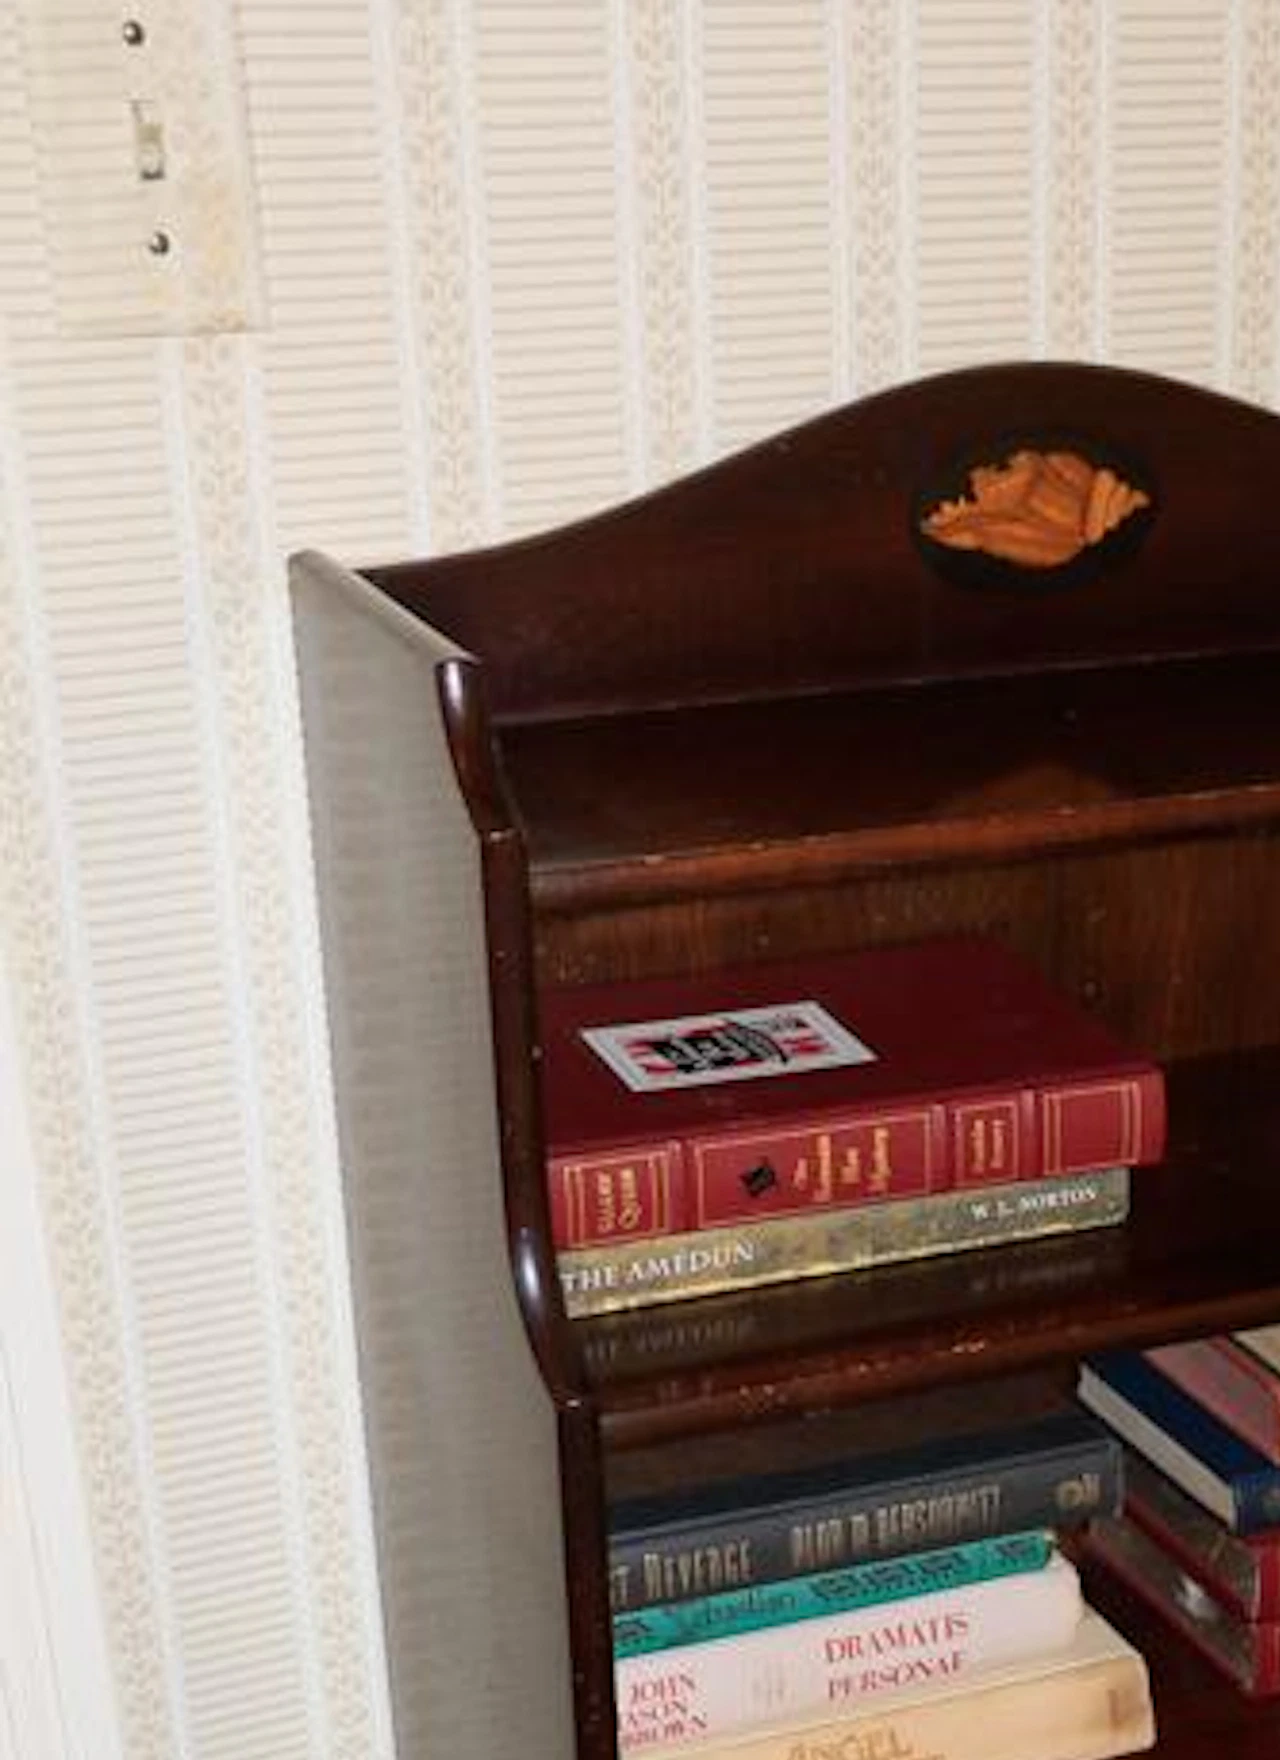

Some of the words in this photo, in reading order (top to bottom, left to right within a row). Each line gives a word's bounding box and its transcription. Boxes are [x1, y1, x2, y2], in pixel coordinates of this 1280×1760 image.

[1018, 1186, 1098, 1213] NORTON
[559, 1265, 618, 1293] THE
[823, 1612, 971, 1666] DRAMATIS
[629, 1674, 697, 1705] JOHN
[827, 1650, 968, 1701] PERSONAE
[622, 1699, 689, 1730] ASON
